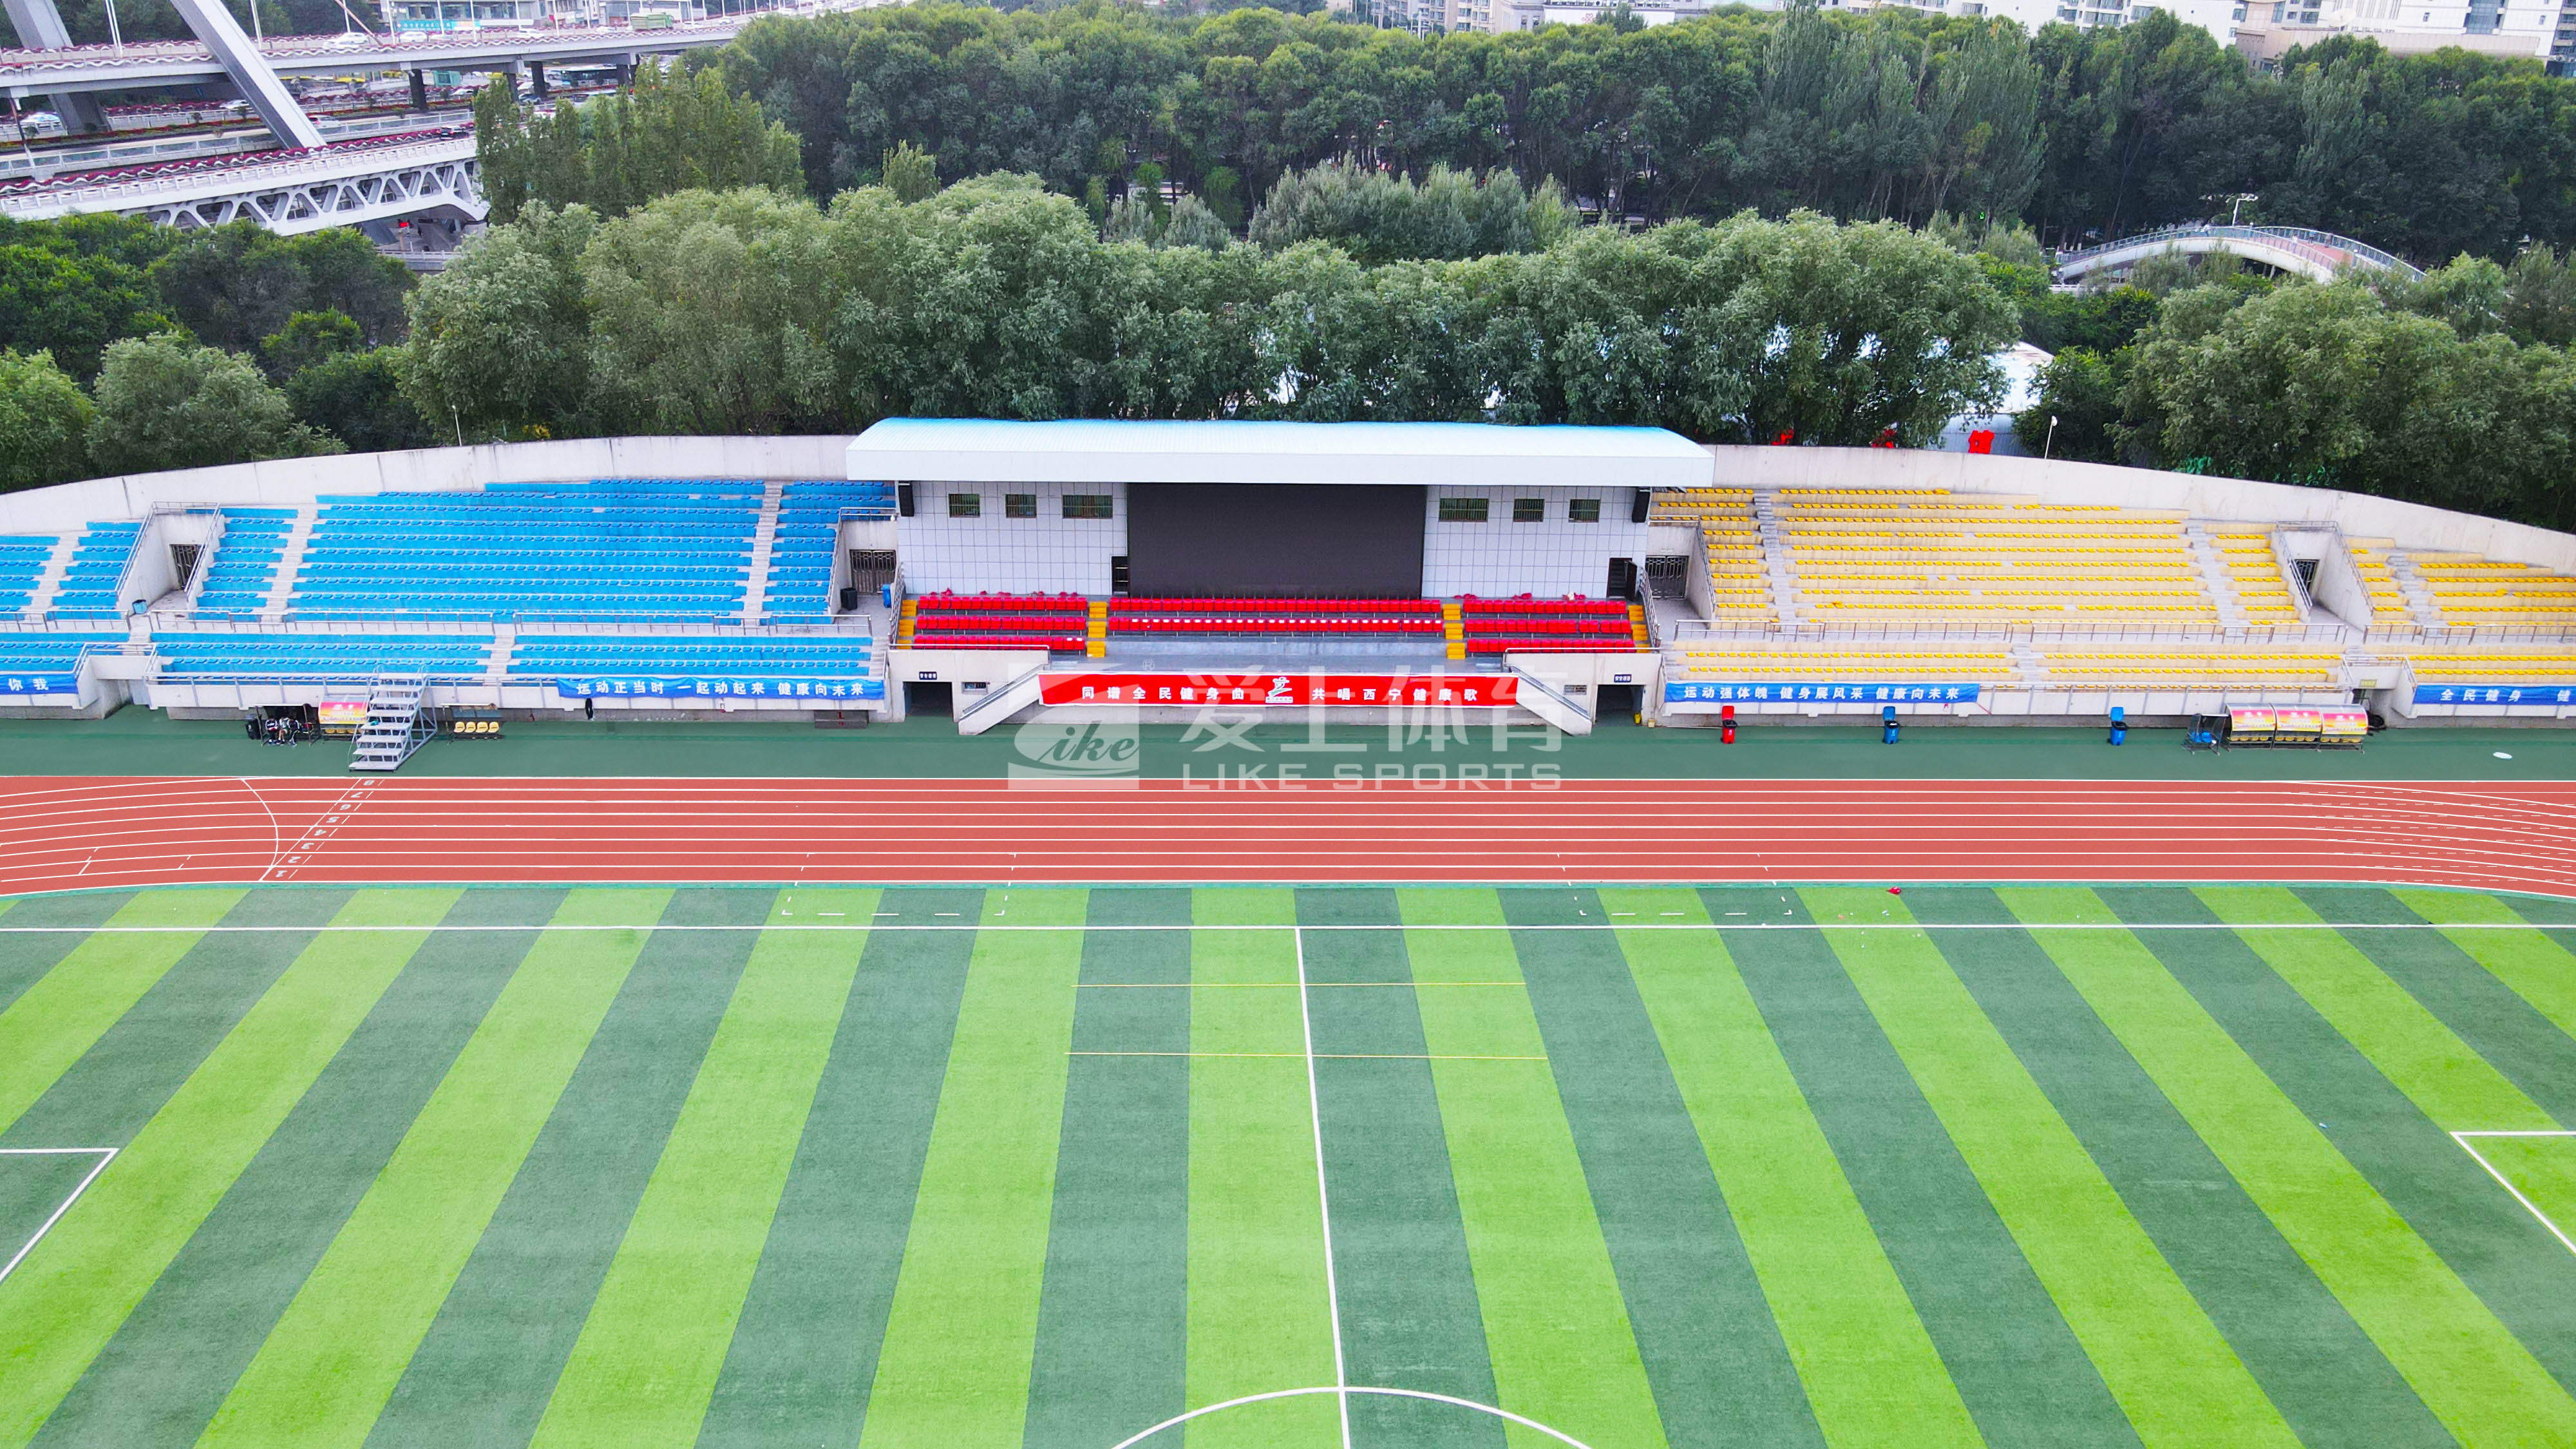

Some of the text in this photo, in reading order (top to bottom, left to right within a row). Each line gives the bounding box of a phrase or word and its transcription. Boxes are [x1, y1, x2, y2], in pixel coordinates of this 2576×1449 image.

[576, 681, 864, 697] 运动正当时 一起动起来 健康向未来
[1082, 687, 1477, 701] 同谱全民健身曲 共唱西宁健康歌
[1684, 686, 1960, 701] 运动强体魄 健身展风采 健康向未来
[2440, 688, 2521, 701] 全民健身
